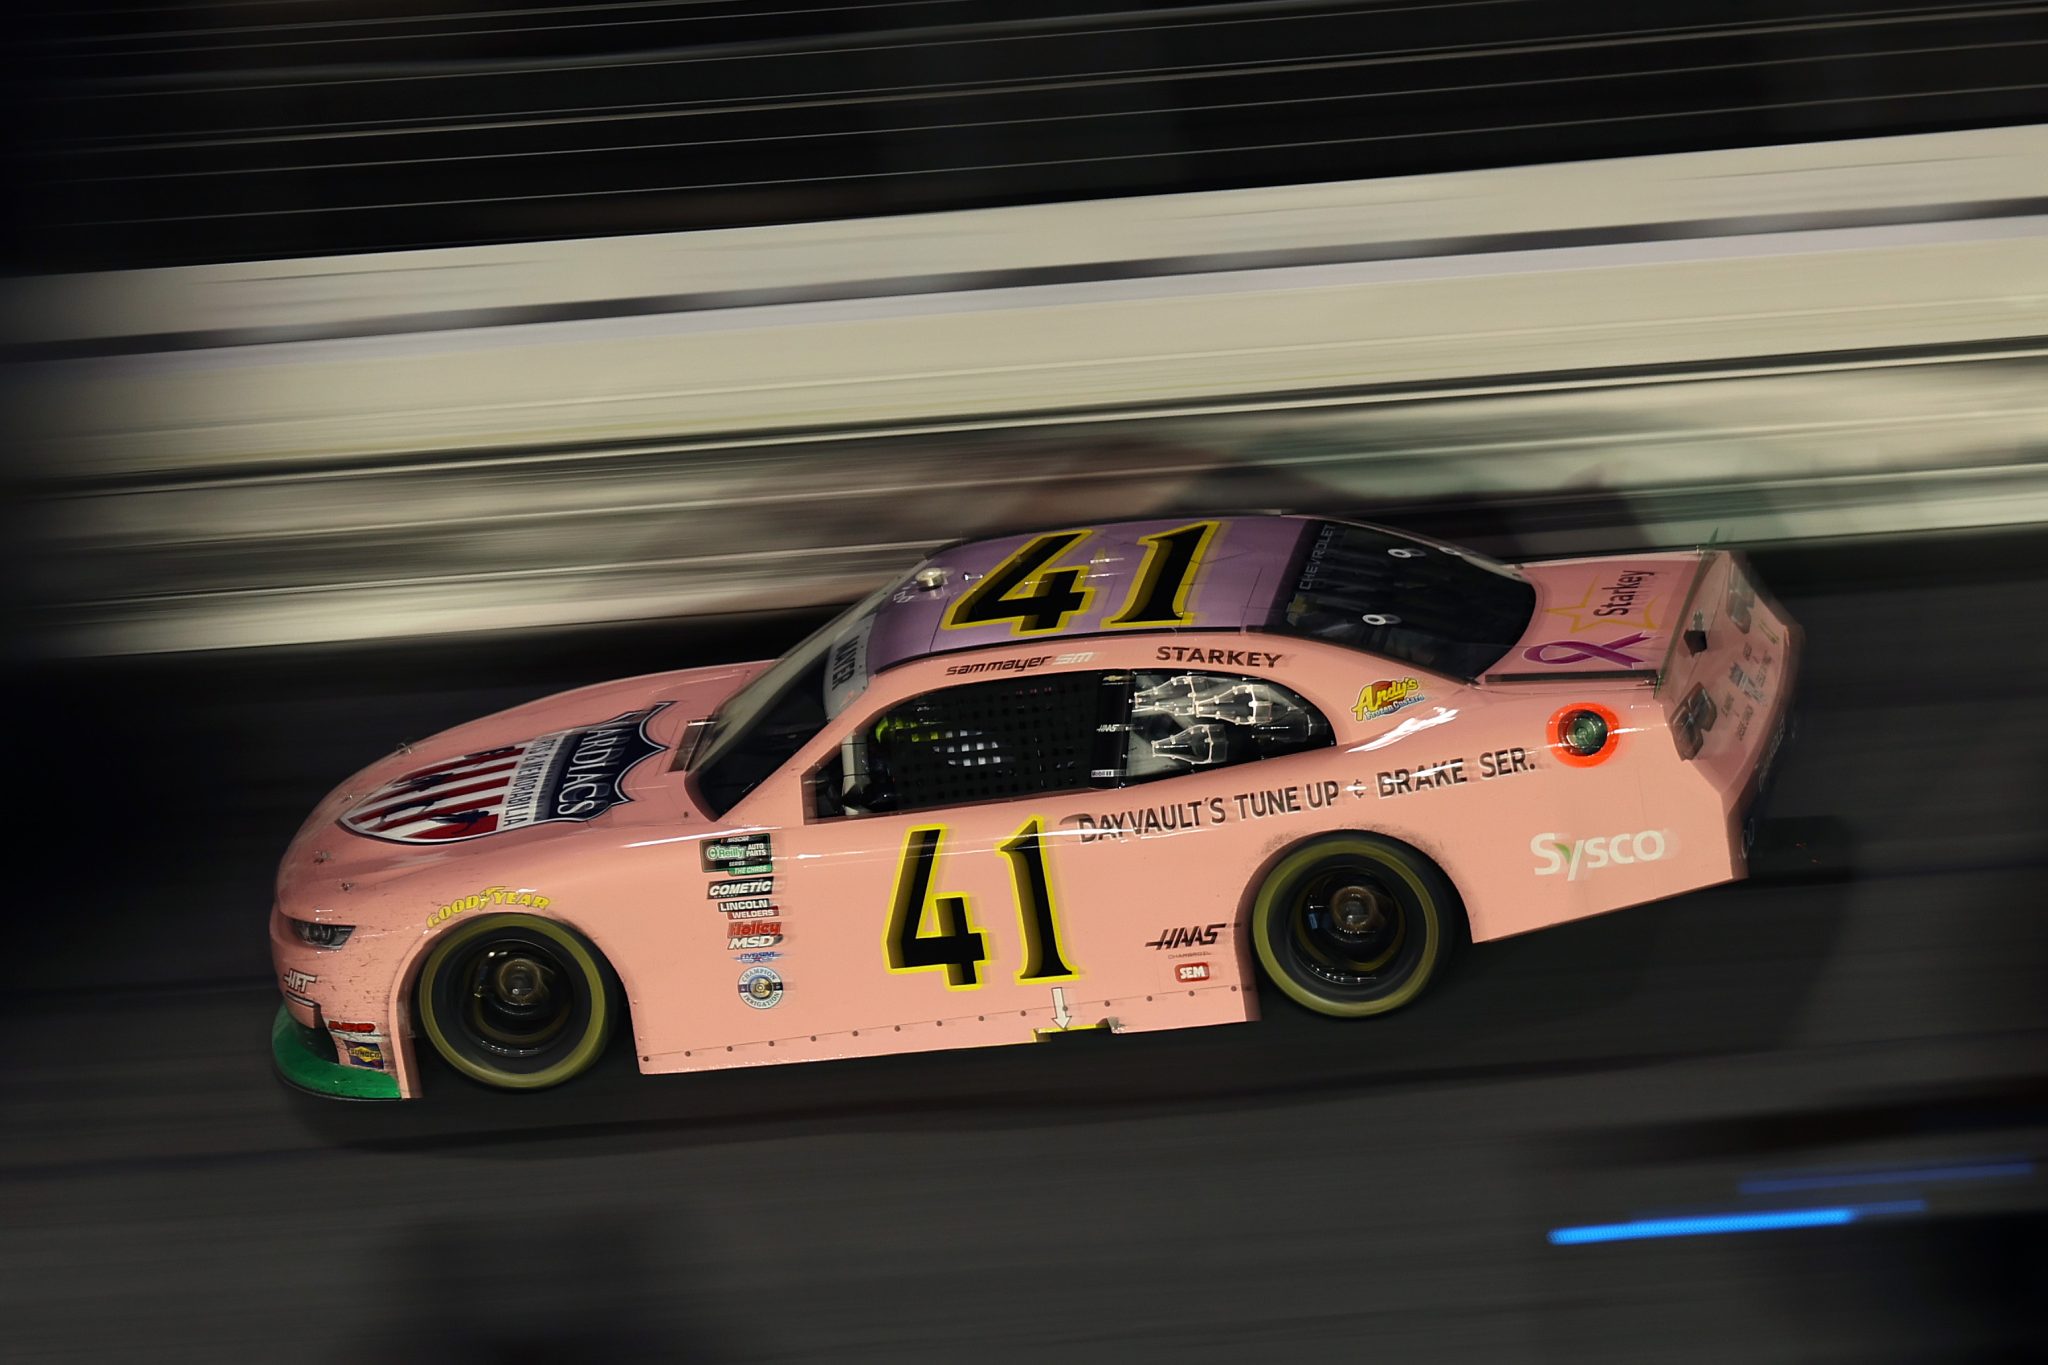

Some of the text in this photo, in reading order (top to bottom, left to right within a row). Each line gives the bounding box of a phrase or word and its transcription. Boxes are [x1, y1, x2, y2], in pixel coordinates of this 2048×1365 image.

[1299, 524, 1335, 590] CHEVROLET
[942, 521, 1220, 635] 41
[1593, 569, 1655, 617] Starkey
[832, 635, 860, 691] MAYER
[1156, 645, 1284, 668] STARKEY
[1351, 676, 1418, 721] Andy's
[557, 720, 627, 815] ARDIACS
[1078, 796, 1226, 843] DAYVAULT'S
[1234, 785, 1301, 820] TUNE
[1307, 780, 1340, 809] UP
[1377, 757, 1468, 799] BRAKE
[1480, 746, 1537, 779] SER.
[707, 845, 746, 861] O'Reilly
[709, 880, 772, 896] COMETIC
[426, 886, 550, 928] GOODYEAR
[720, 899, 768, 911] LINCOLN
[732, 909, 775, 919] WELDERS
[881, 815, 1078, 990] 41
[729, 920, 782, 937] Holley
[1145, 922, 1227, 950] HAAS
[728, 935, 775, 949] MSD
[742, 968, 778, 983] CHAMPION
[1179, 965, 1206, 980] SEM
[743, 991, 781, 1008] IRRIGATION
